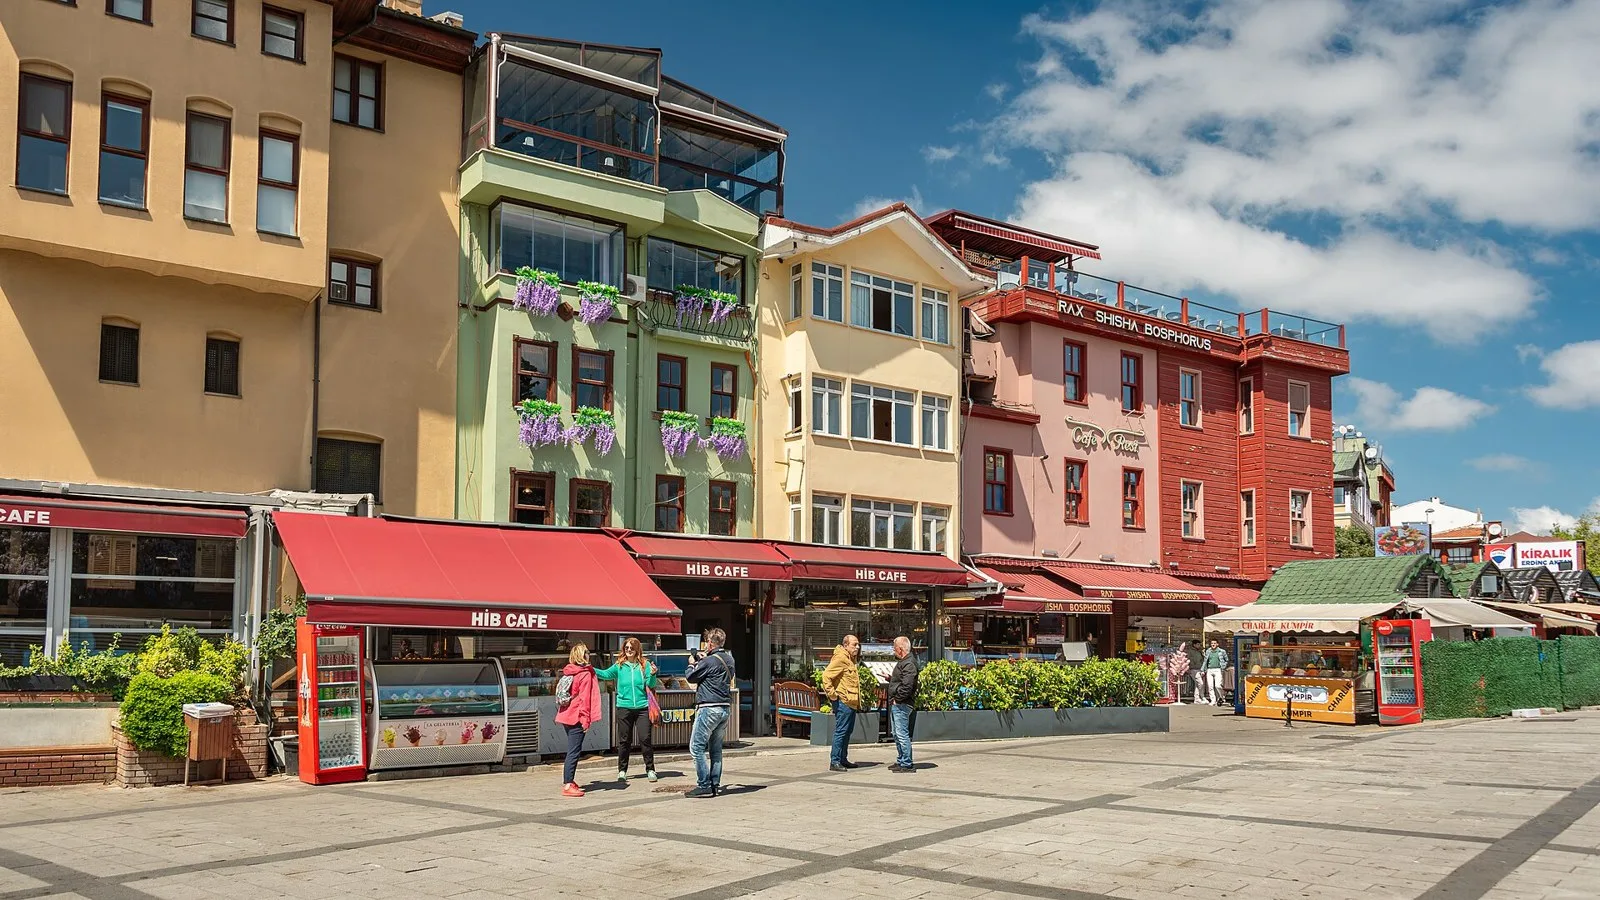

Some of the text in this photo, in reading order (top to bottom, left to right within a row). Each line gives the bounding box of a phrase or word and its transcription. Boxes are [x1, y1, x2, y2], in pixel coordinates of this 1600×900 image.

[1058, 300, 1212, 351] RAX SHISHA BOSPHORUS
[1072, 426, 1097, 448] Cafe
[1521, 548, 1572, 559] KİRALIK
[686, 562, 749, 578] HİB CAFE
[855, 567, 907, 582] HİB CAFE
[1100, 590, 1200, 600] RAX SHISHA BOSPHORUS
[1069, 603, 1111, 612] BOSPHORUS
[471, 608, 548, 629] HİB CAFE
[1241, 620, 1315, 630] CHARLİE KUMPİR
